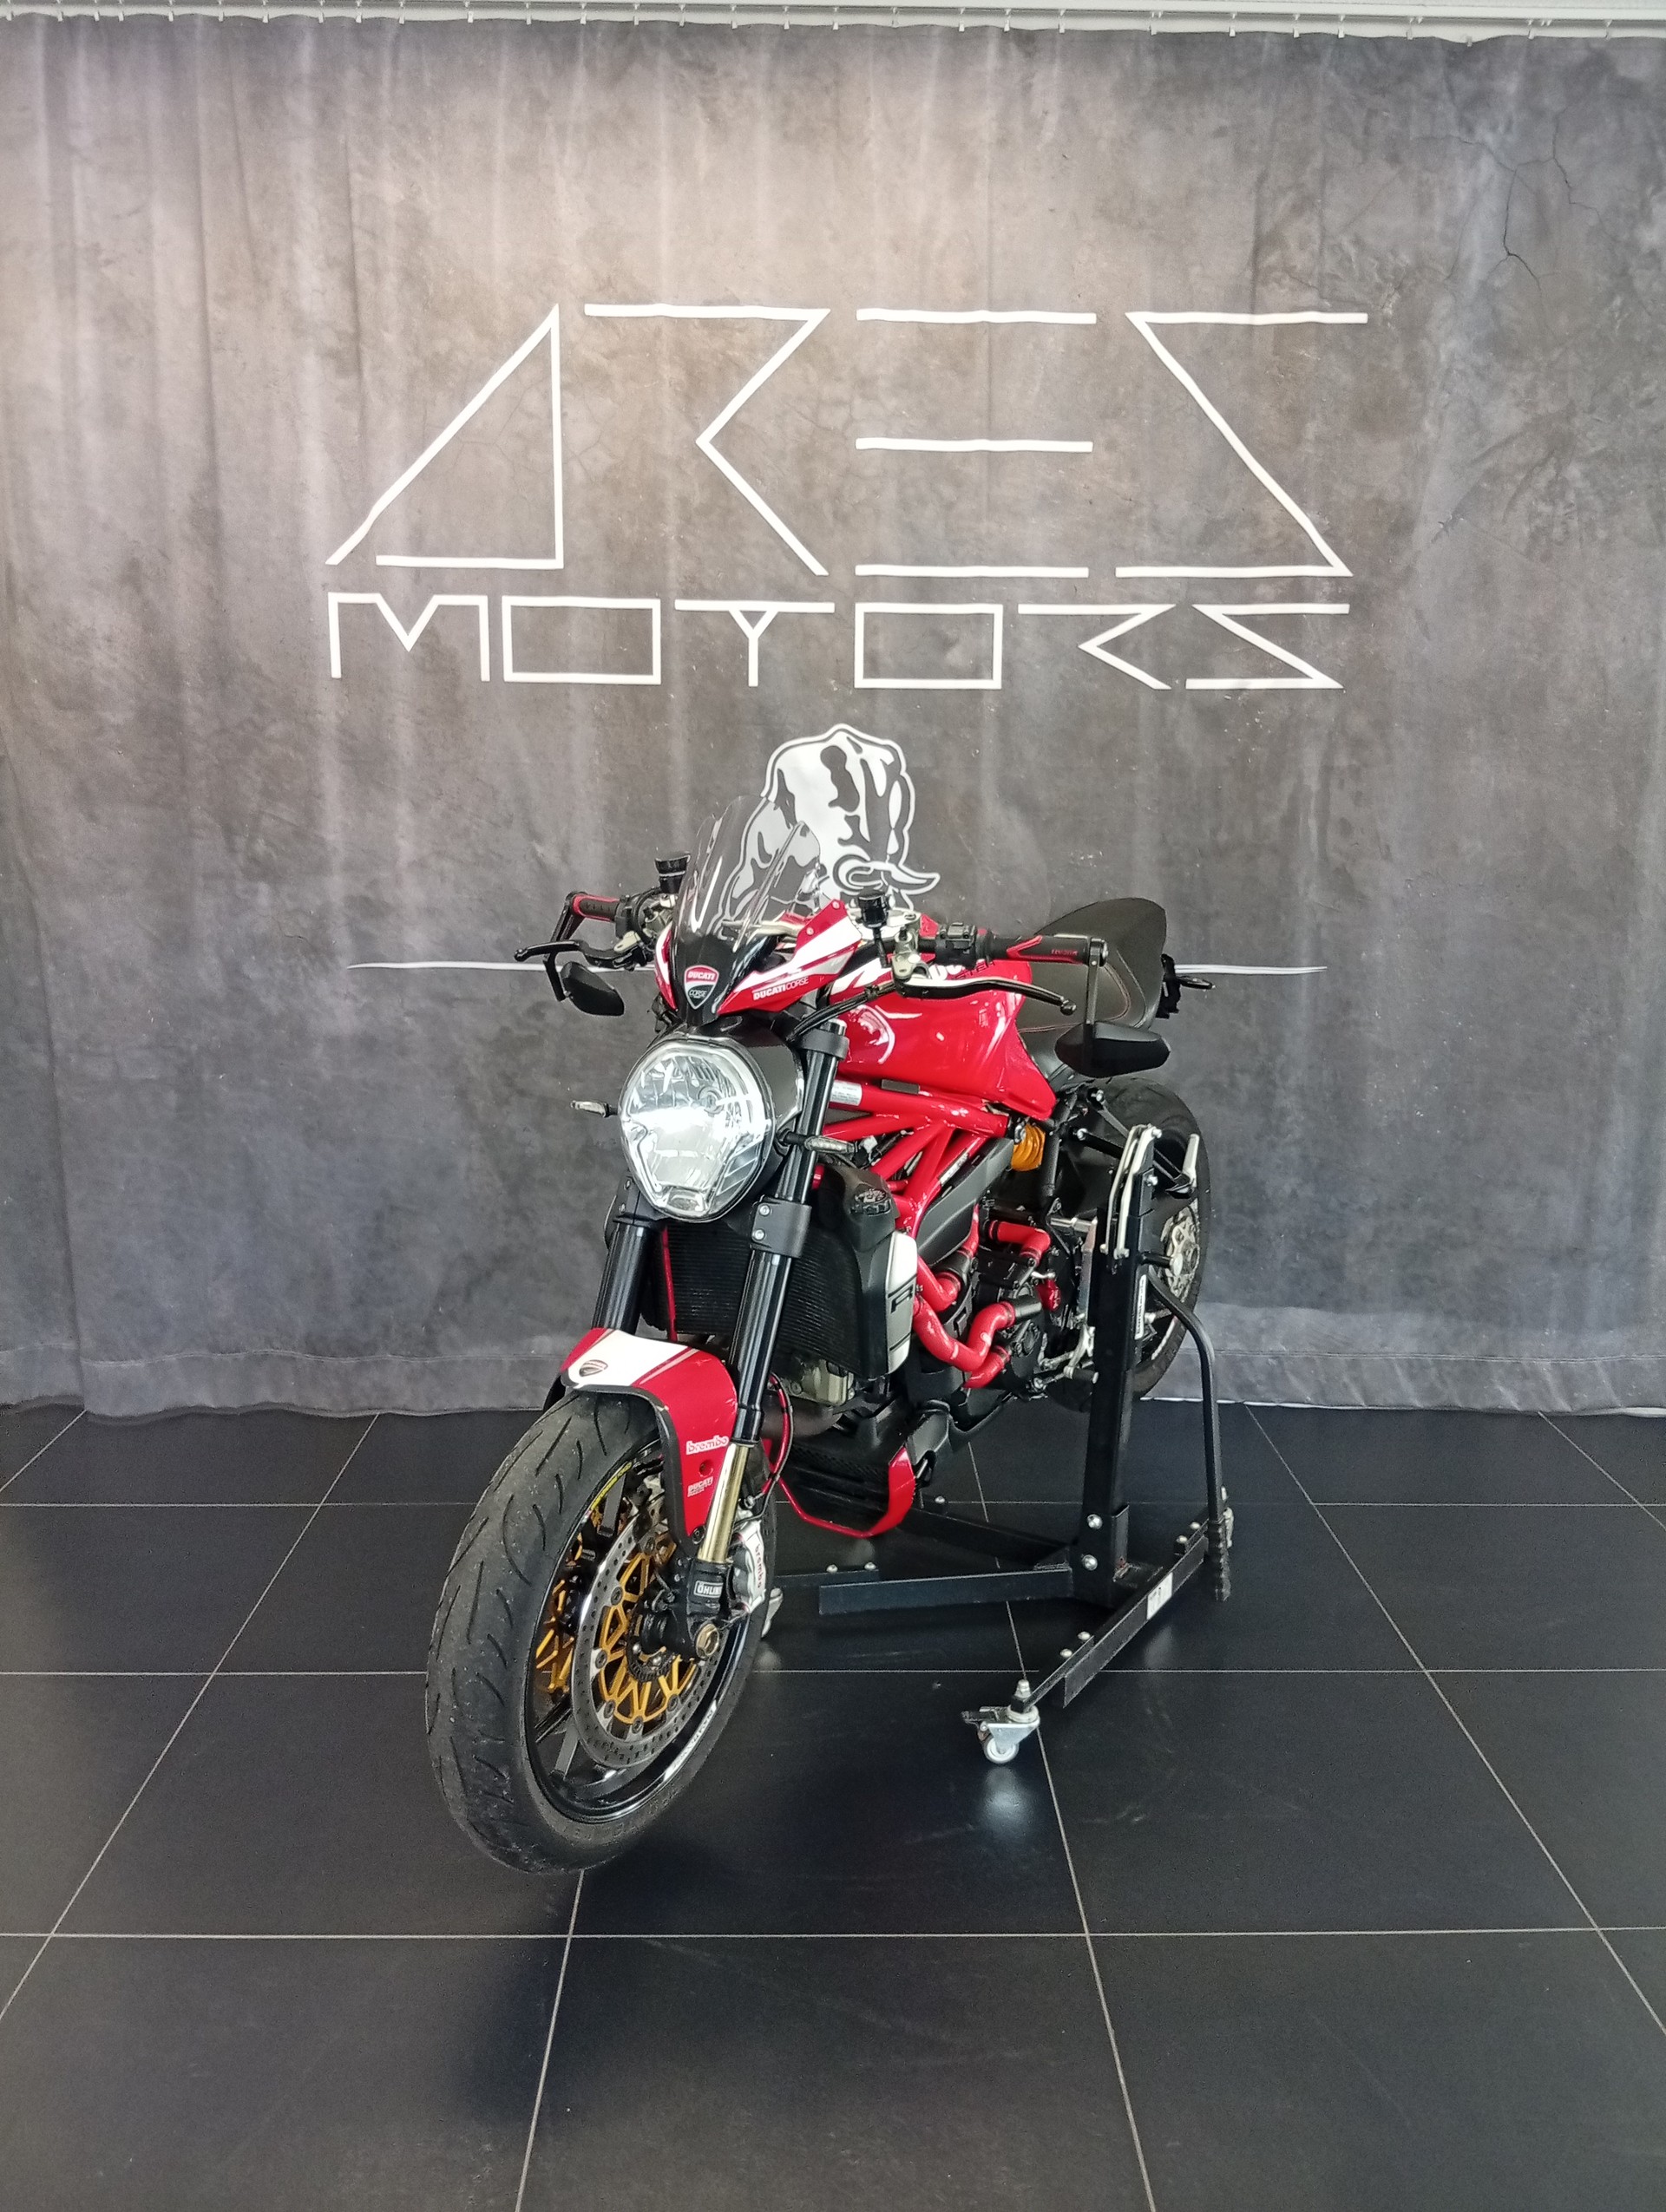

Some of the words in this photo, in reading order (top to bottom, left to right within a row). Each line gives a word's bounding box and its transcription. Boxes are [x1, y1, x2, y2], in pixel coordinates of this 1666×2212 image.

[325, 304, 1368, 579] ARES
[328, 592, 1350, 690] MOTORS
[687, 972, 716, 980] DUCATI
[753, 985, 786, 1001] DUCATI
[786, 976, 810, 991] CORSE
[689, 989, 707, 998] CORSE
[686, 1436, 729, 1454] brembo
[754, 1543, 764, 1589] brembo
